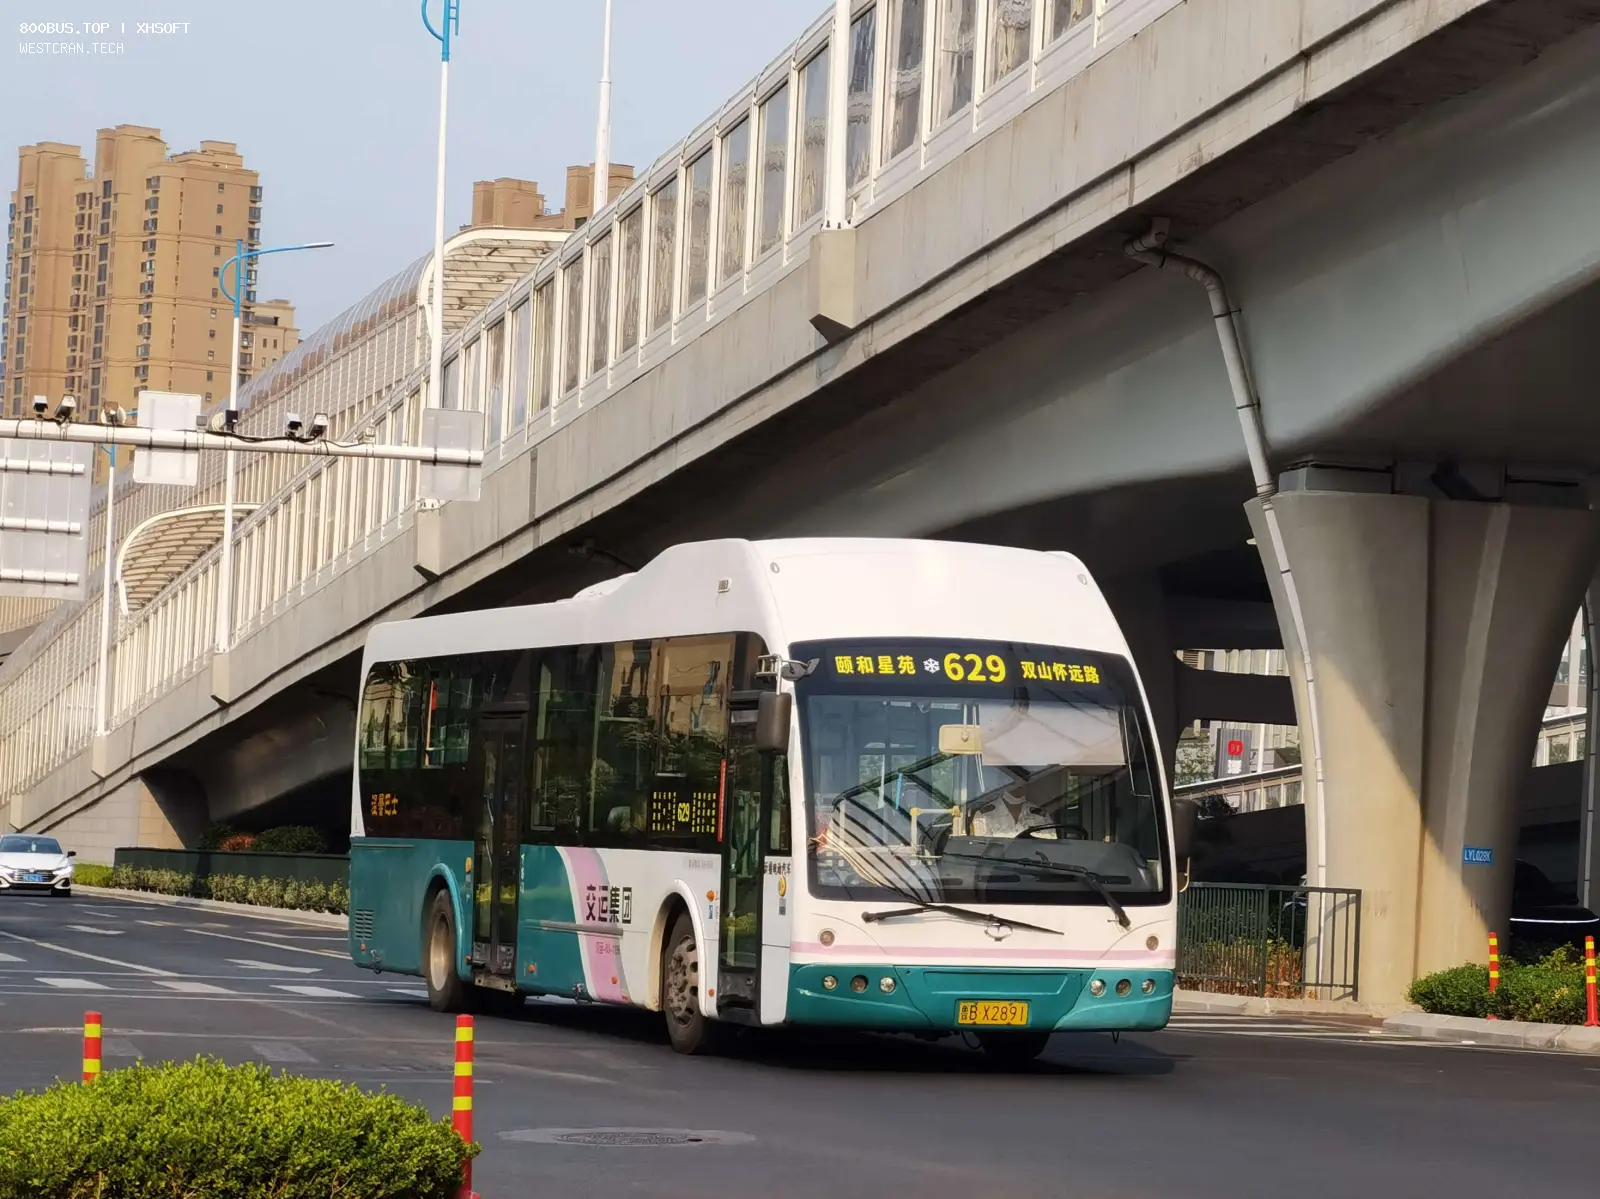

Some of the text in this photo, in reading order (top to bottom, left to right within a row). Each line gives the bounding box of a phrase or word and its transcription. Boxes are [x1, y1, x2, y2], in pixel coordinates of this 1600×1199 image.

[835, 653, 1100, 684] 颐和星苑 629 双山怀远路
[678, 802, 690, 822] 629
[586, 883, 632, 925] 交运集团
